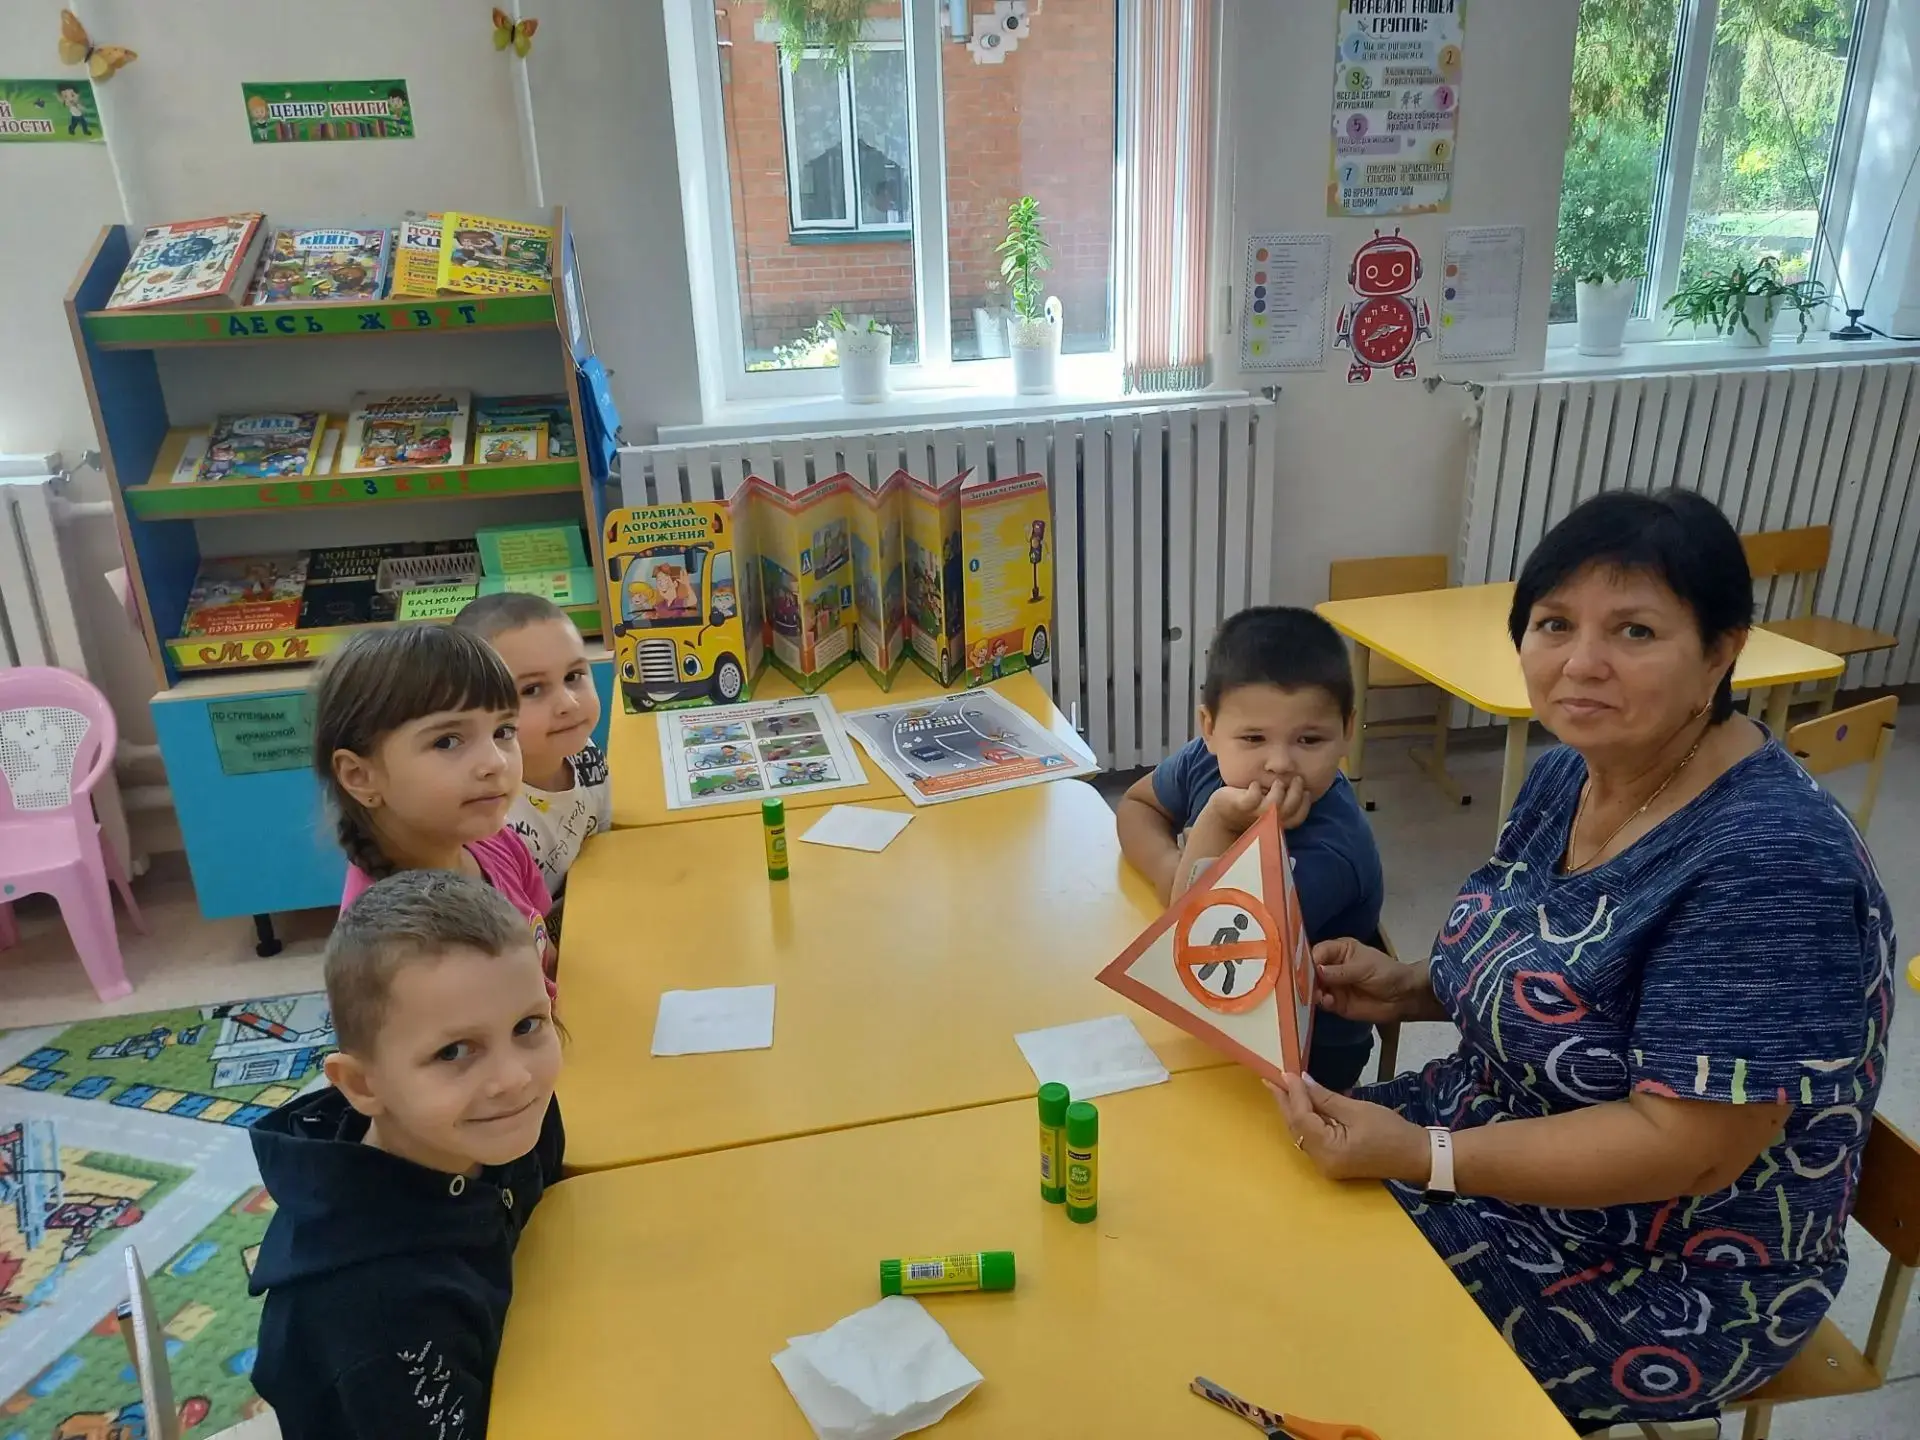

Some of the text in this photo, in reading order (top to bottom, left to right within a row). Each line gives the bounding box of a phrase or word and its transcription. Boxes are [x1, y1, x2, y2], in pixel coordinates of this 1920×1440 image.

[269, 102, 388, 121] ЦЕНТР КНИГИ
[631, 507, 696, 521] ПРАВИЛА
[621, 517, 708, 534] ДОРОЖНОГО
[627, 529, 706, 546] ДВИЖЕНИЯ
[330, 564, 375, 577] МИРА
[410, 607, 458, 618] КАРТЫ
